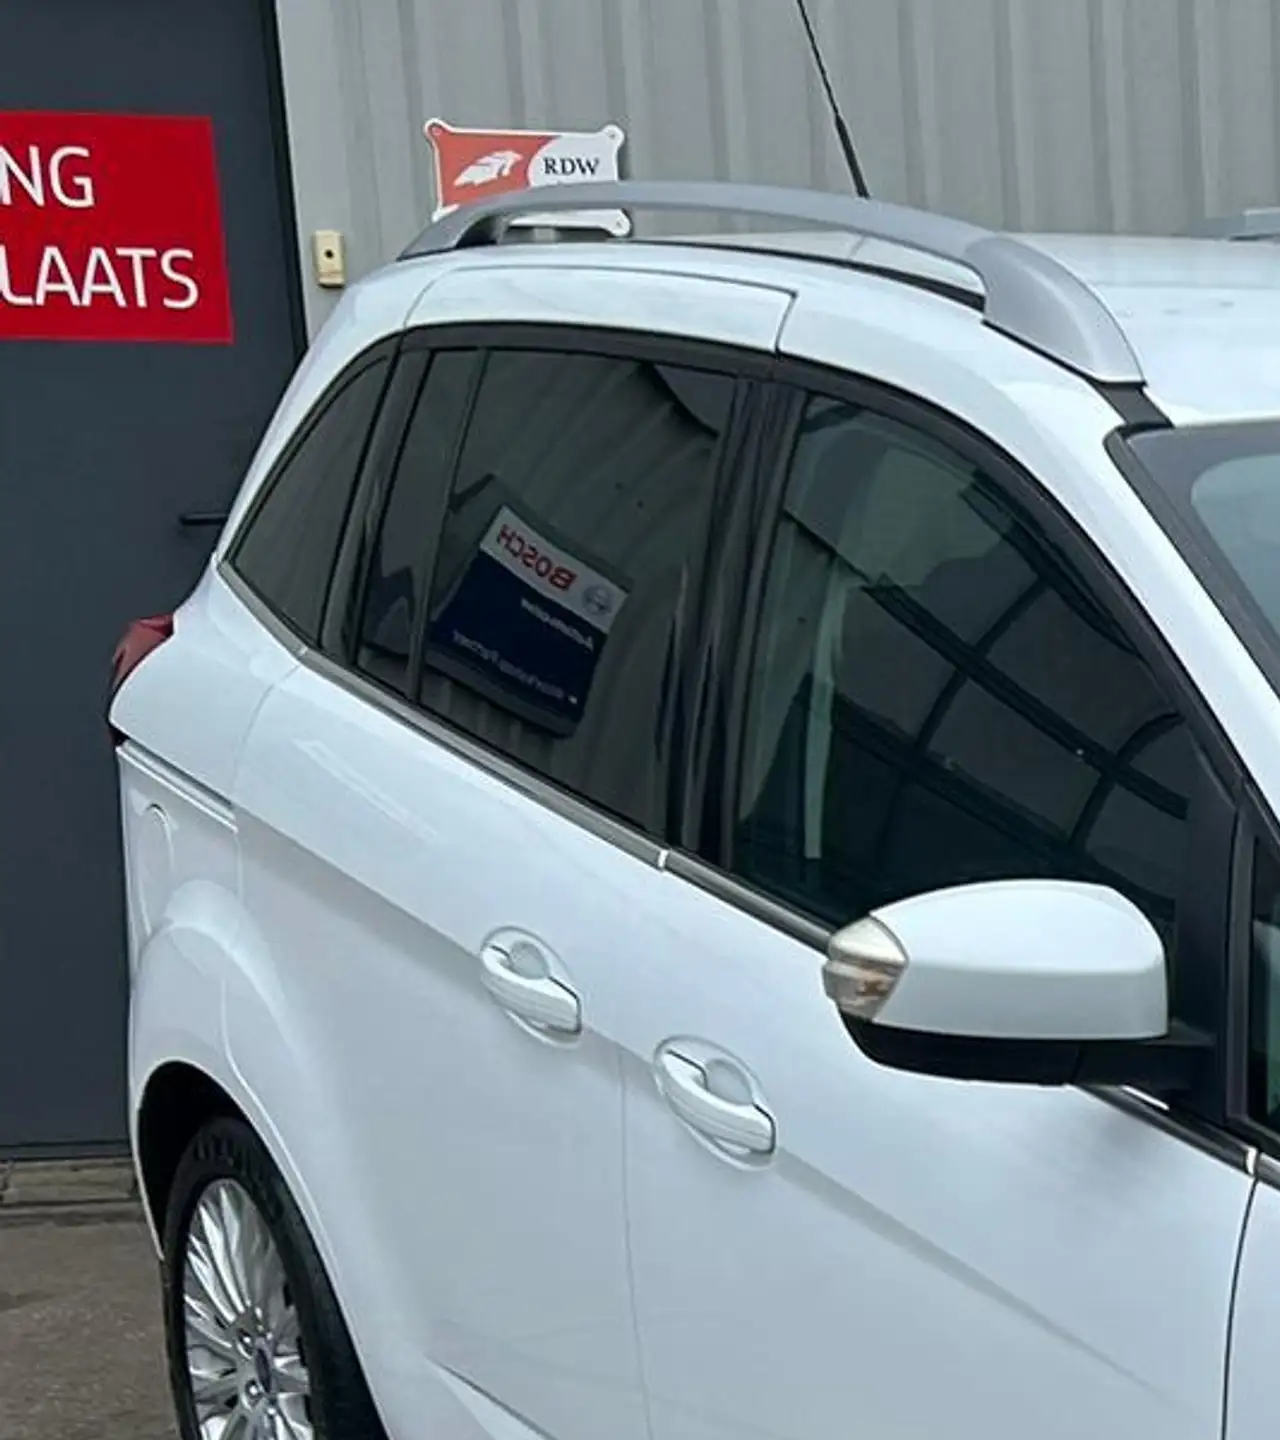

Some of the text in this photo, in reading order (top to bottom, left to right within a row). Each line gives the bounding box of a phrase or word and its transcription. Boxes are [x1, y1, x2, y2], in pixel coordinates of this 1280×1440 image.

[0, 145, 95, 208] NG
[543, 157, 600, 175] RDW
[0, 245, 199, 308] LAATS
